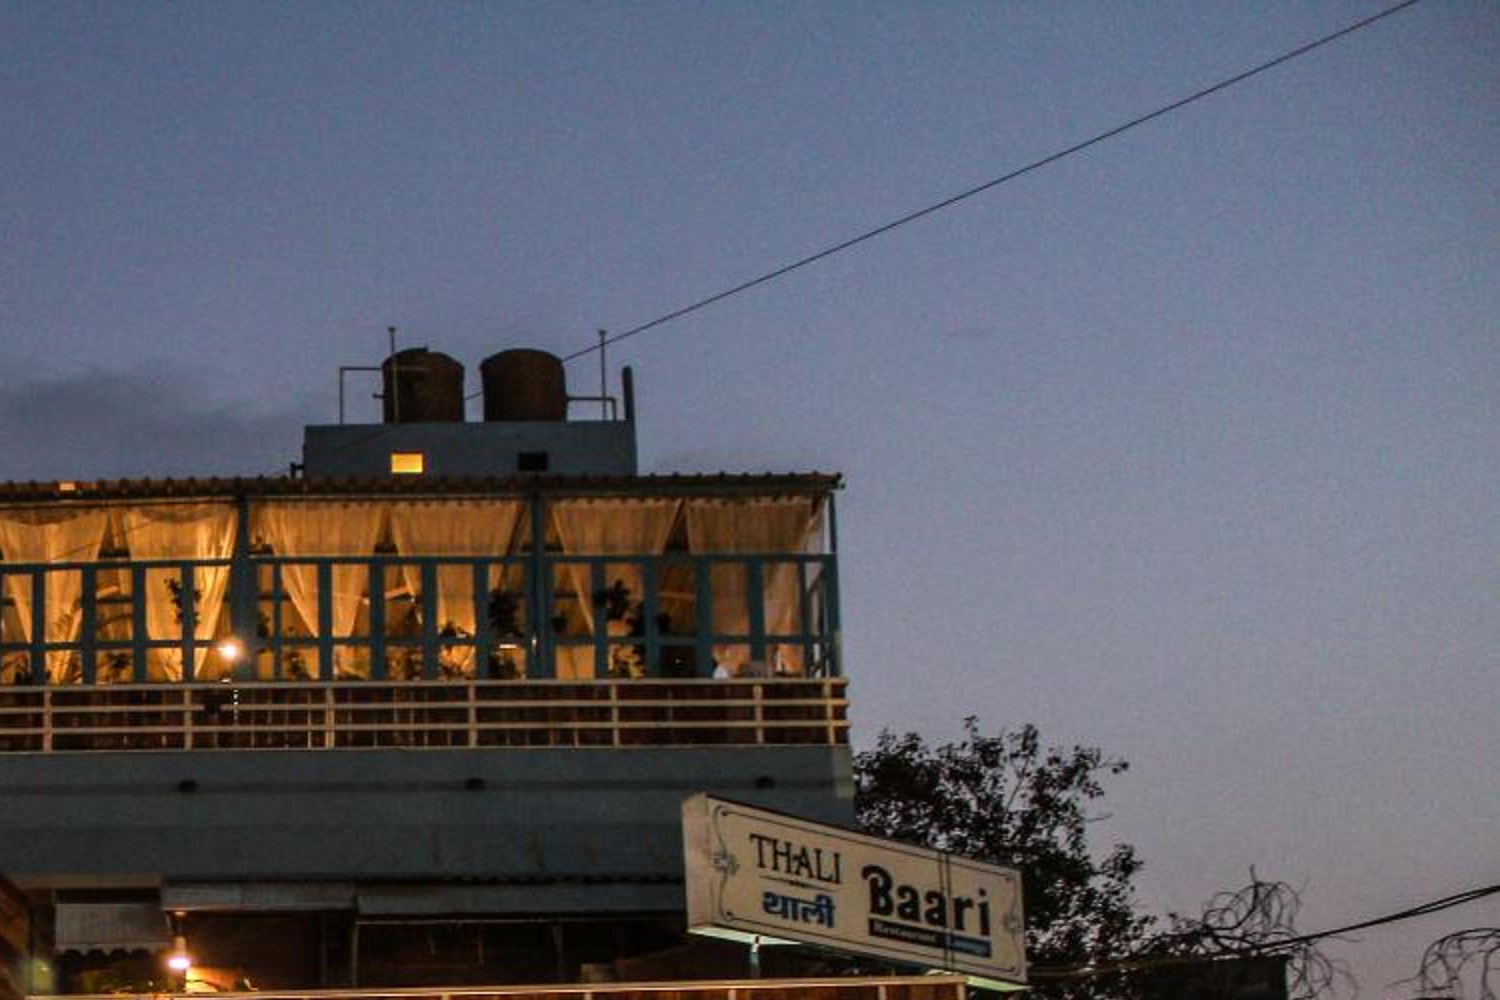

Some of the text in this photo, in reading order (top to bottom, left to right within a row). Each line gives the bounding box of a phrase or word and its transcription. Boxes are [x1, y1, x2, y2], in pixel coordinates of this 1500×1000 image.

[750, 833, 842, 884] THALI
[762, 890, 835, 928] थाली
[862, 864, 991, 935] Baari
